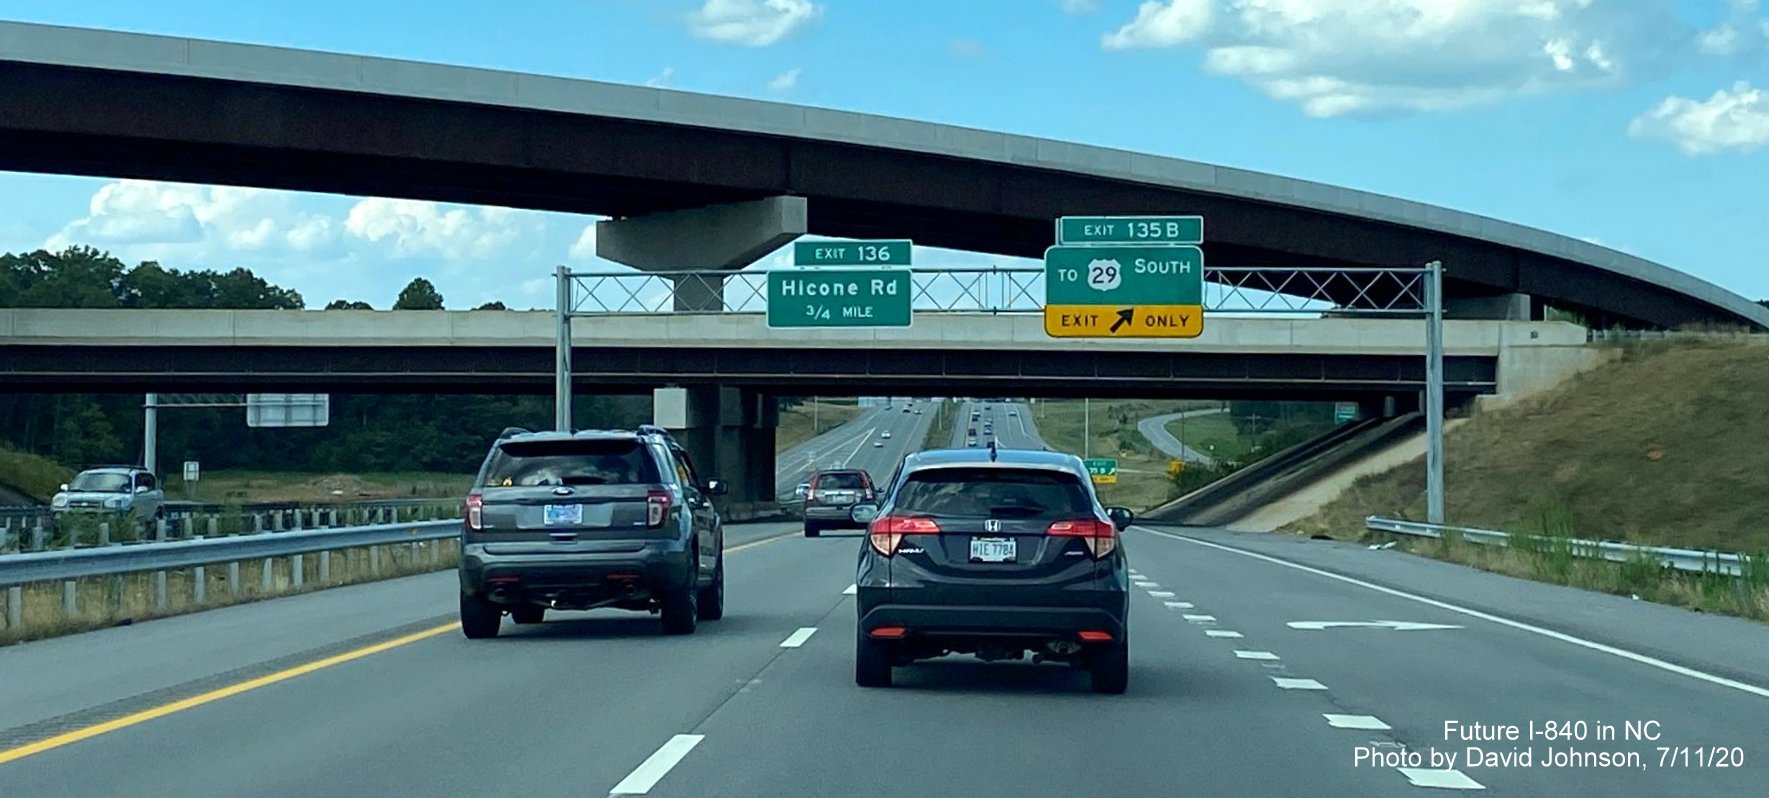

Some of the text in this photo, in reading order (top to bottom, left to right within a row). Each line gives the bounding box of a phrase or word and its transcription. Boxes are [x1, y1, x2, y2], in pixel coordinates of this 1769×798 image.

[1083, 224, 1115, 236] EXIT
[814, 246, 891, 261] EXIT 136
[1057, 258, 1191, 284] TO 29 SOUTH
[782, 279, 897, 296] Hicone Rd
[806, 305, 873, 320] 3/4 MILE
[1061, 314, 1190, 328] EXIT ONLY
